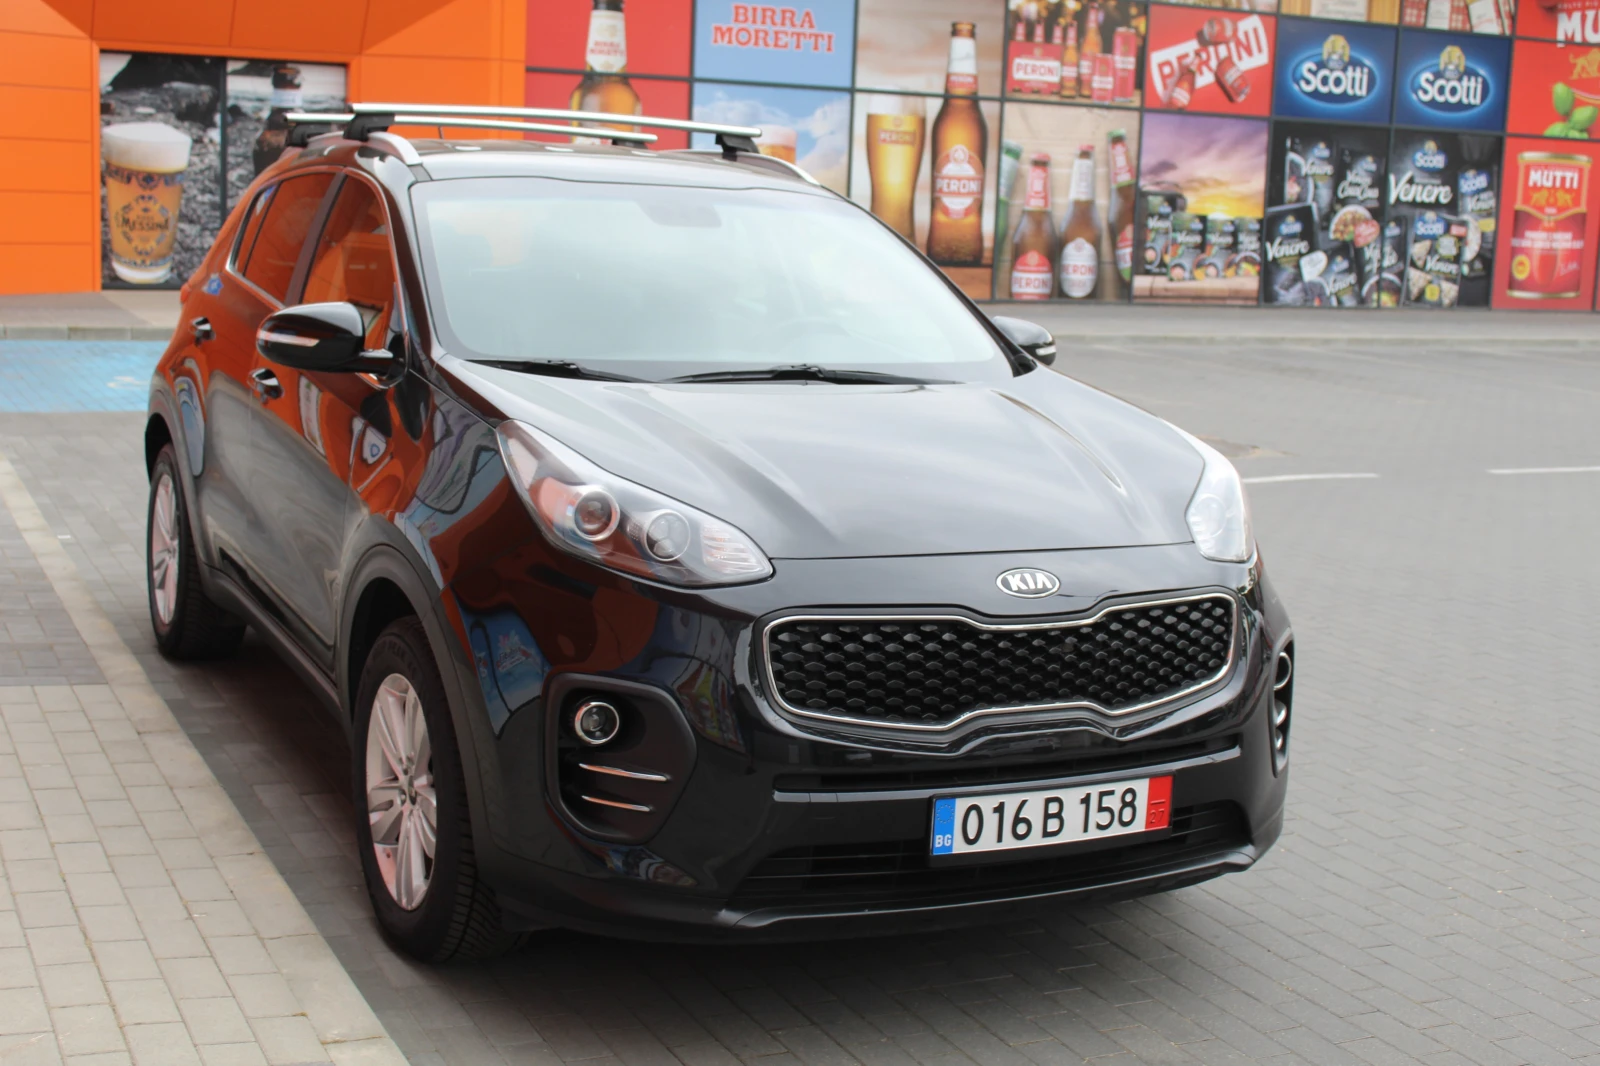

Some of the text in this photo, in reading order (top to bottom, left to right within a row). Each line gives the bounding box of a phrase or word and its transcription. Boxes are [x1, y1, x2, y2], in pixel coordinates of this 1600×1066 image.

[733, 4, 816, 29] BIRRA
[712, 25, 834, 53] MORETTI
[1015, 61, 1059, 77] PERONI
[1299, 60, 1370, 97] Scotti
[1417, 71, 1484, 106] Scotti
[935, 178, 981, 193] PERONI
[1388, 170, 1454, 205] Venere
[1528, 168, 1579, 190] MUTTI
[1265, 236, 1310, 262] Venere
[1005, 573, 1054, 592] KIA
[934, 833, 953, 848] BG
[961, 798, 1034, 846] 016
[1042, 795, 1066, 839] B
[1079, 786, 1138, 834] 158
